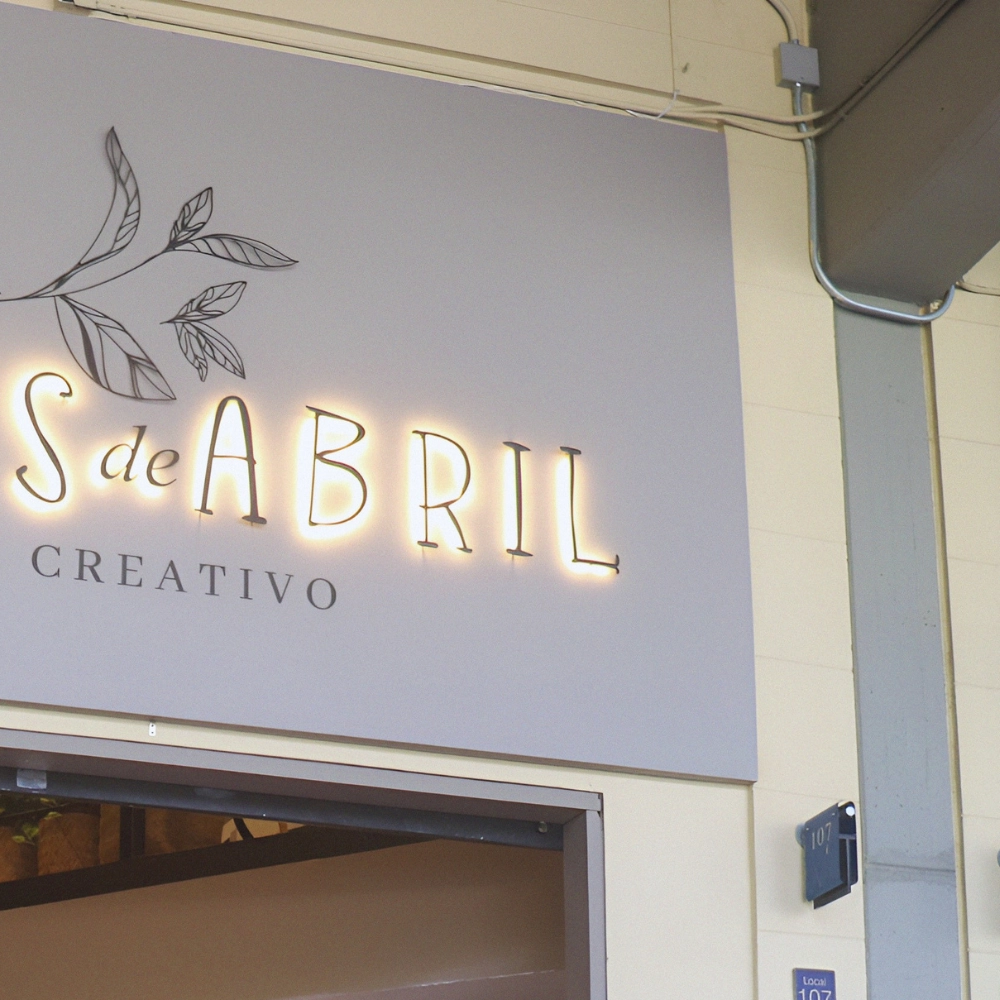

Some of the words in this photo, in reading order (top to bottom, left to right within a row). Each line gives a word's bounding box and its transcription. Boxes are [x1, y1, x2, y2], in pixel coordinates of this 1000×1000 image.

[100, 425, 181, 487] de
[197, 395, 620, 574] ABRIL
[30, 543, 337, 612] CREATIVO
[811, 821, 832, 850] 107
